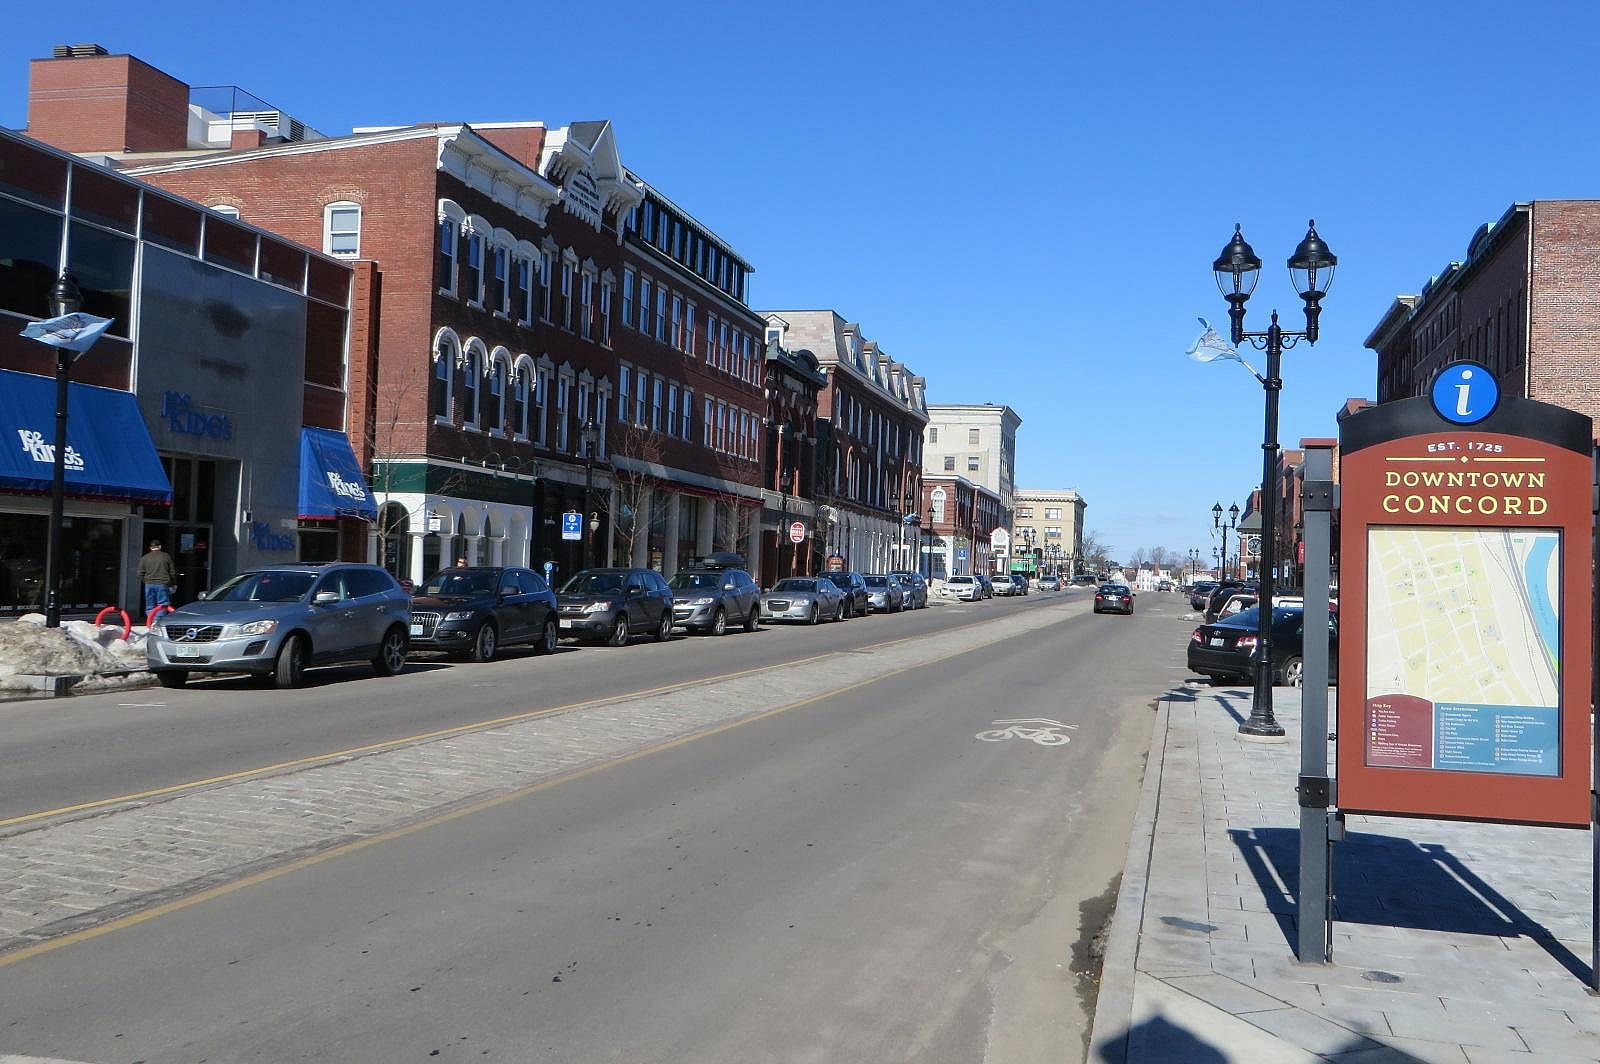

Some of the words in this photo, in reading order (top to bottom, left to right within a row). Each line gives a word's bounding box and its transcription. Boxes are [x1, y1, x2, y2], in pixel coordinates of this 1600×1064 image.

[1427, 441, 1460, 453] EST.
[1467, 441, 1503, 453] 1725
[1385, 471, 1546, 488] DOWNTOWN
[1382, 494, 1548, 515] CONCORD
